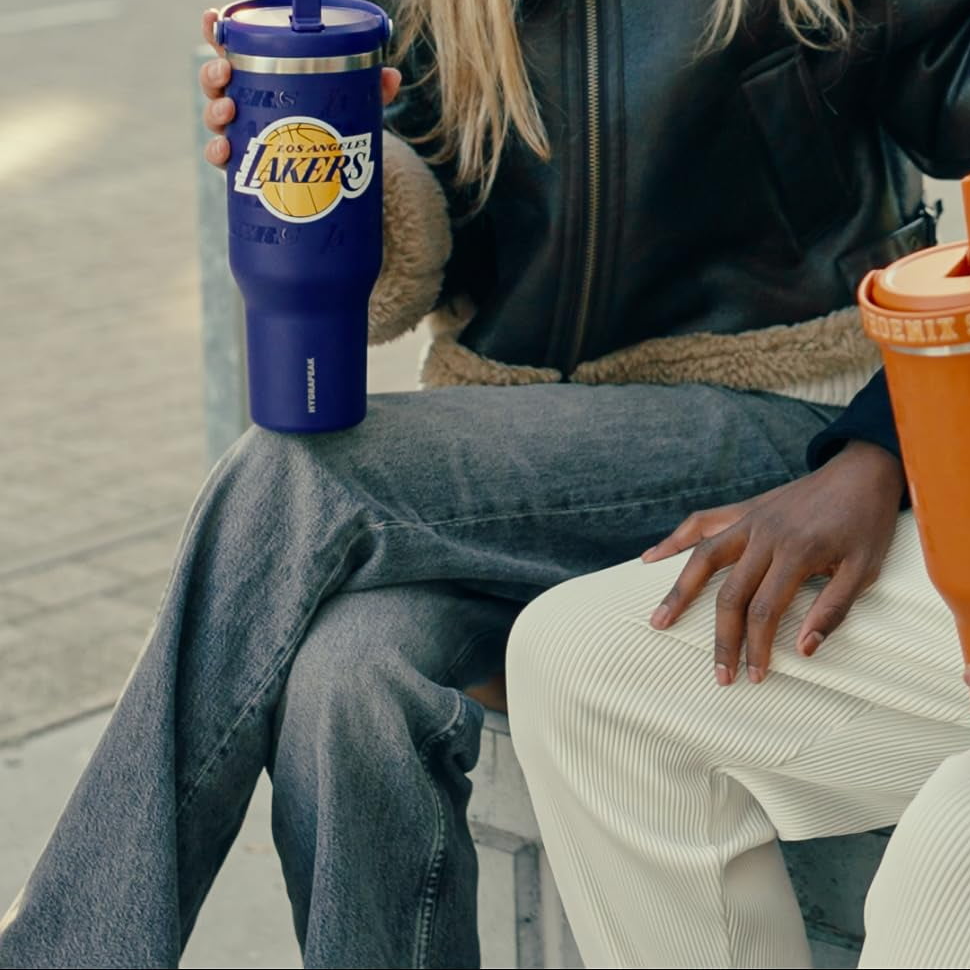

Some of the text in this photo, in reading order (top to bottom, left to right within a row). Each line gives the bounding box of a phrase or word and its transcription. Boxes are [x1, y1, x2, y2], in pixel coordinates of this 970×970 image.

[277, 138, 368, 153] LOS ANGELES
[240, 143, 368, 192] LAKERS
[863, 311, 959, 343] HOENIX
